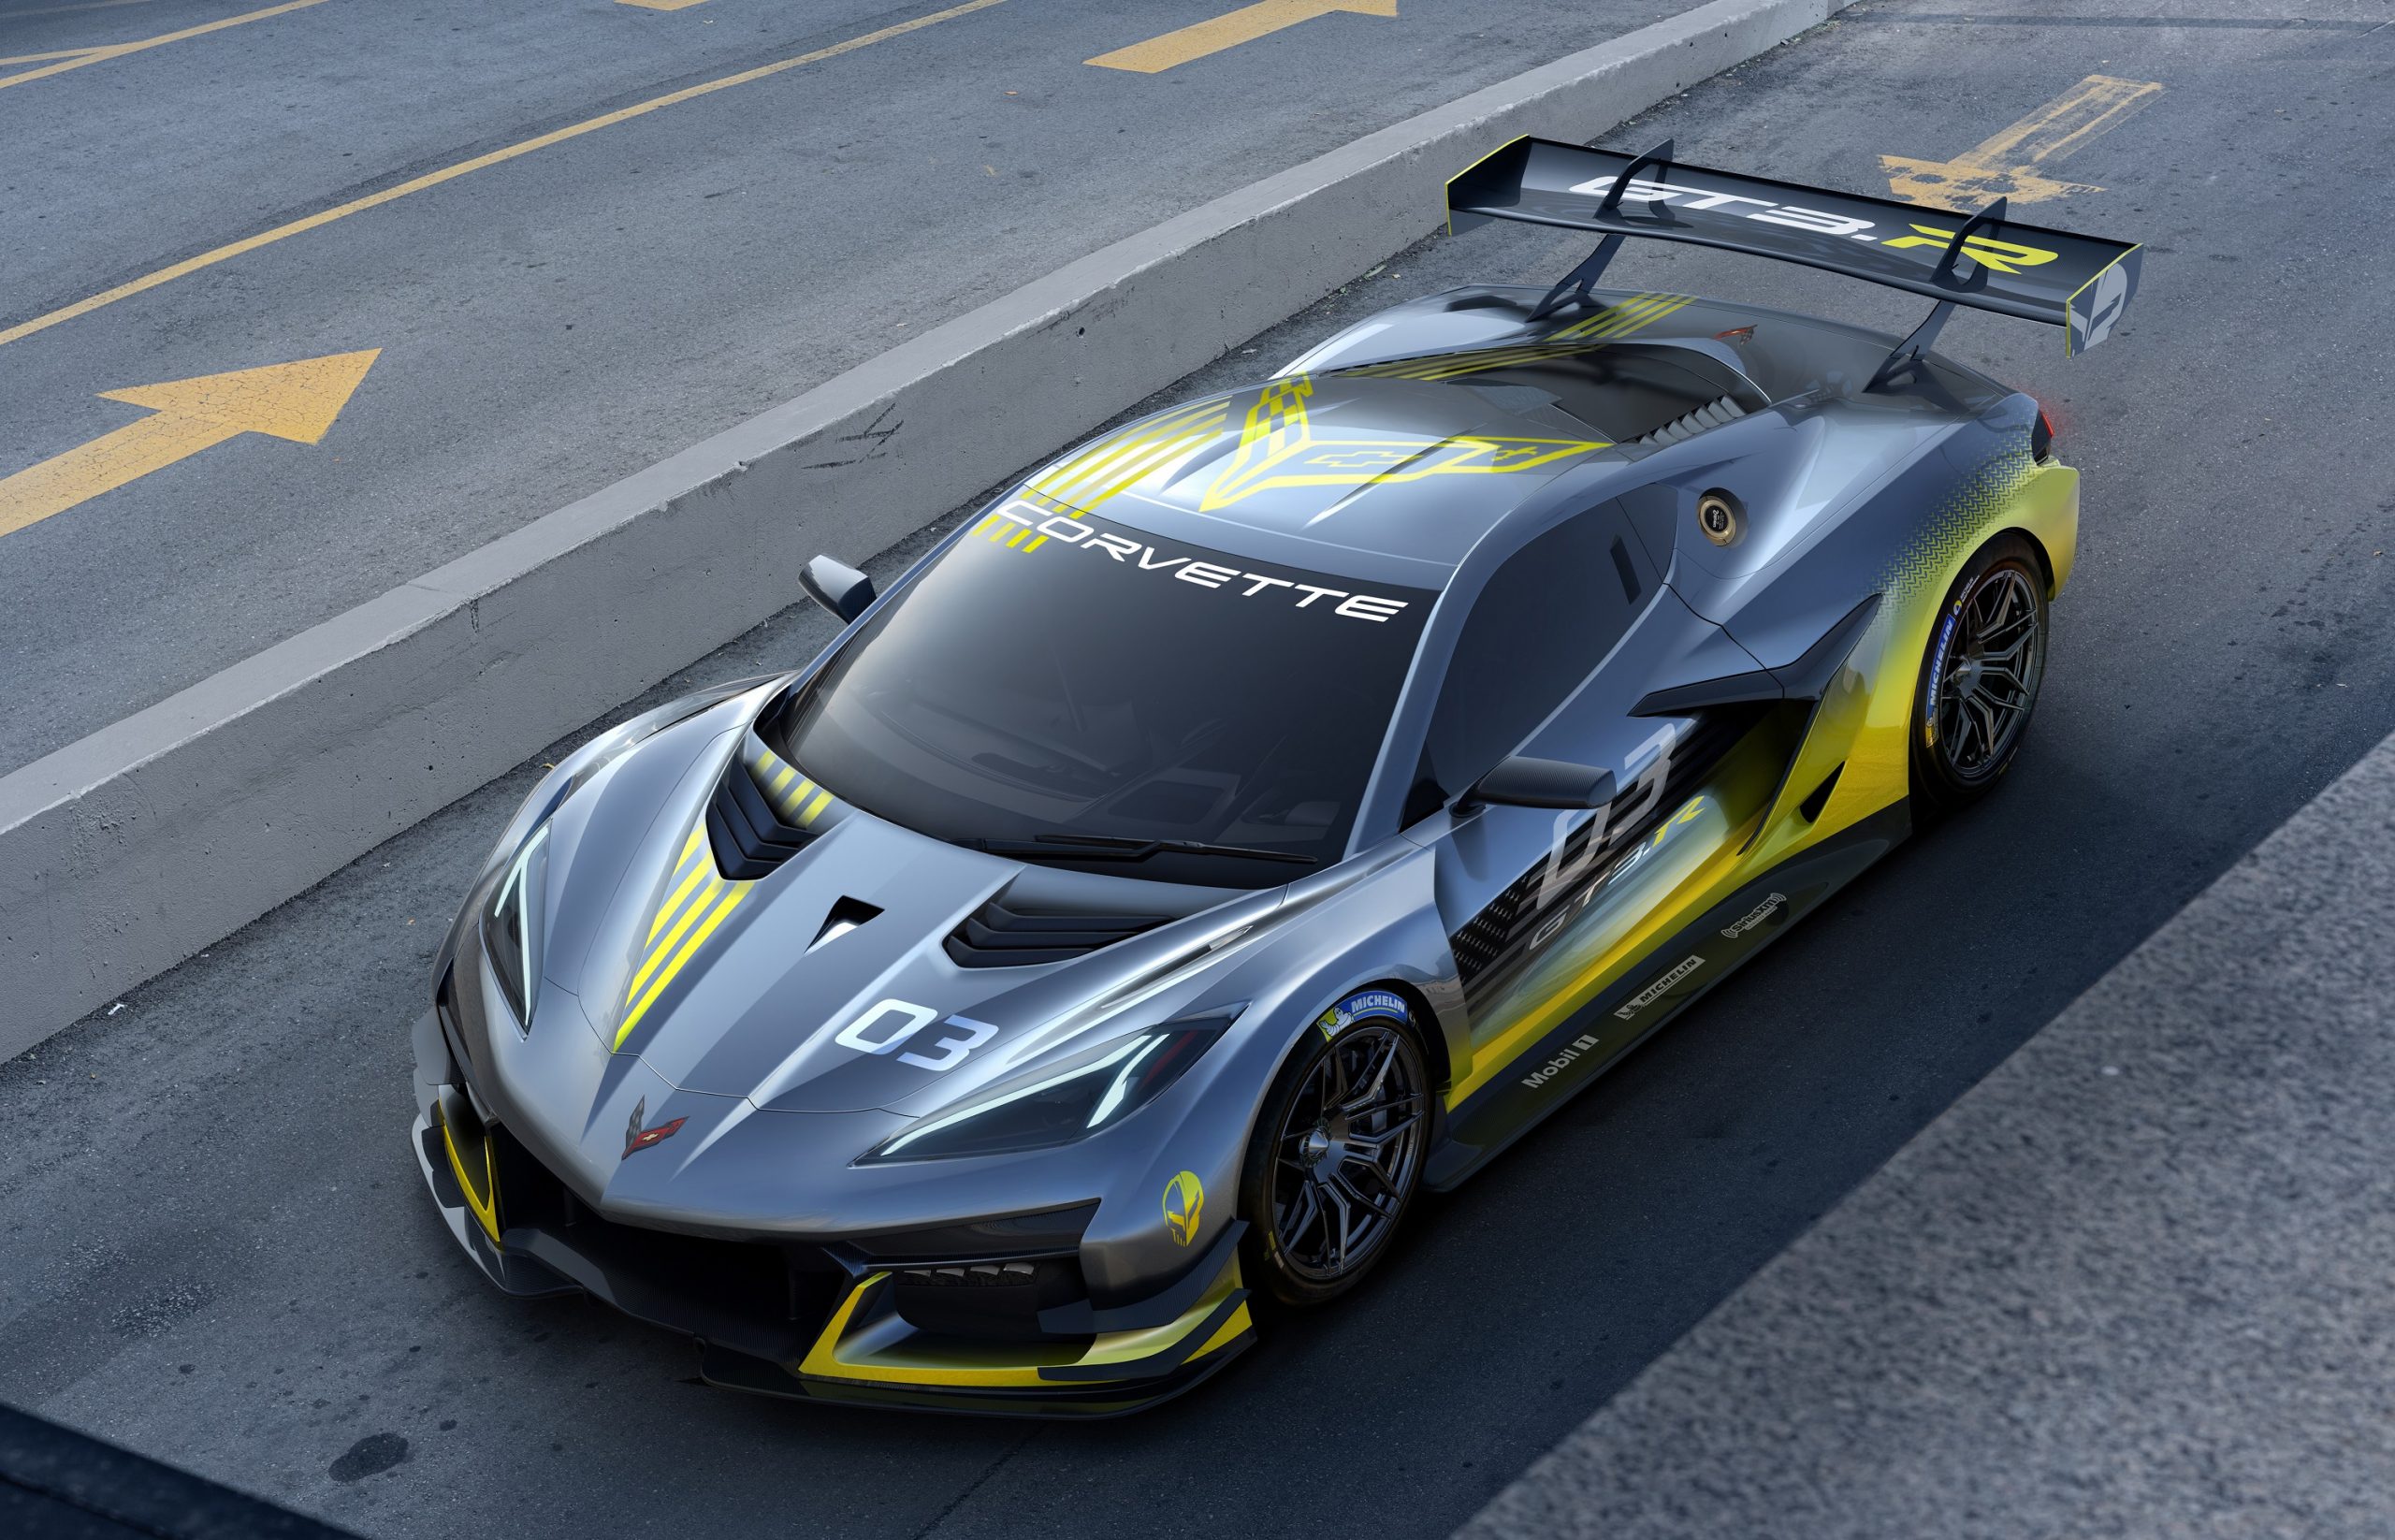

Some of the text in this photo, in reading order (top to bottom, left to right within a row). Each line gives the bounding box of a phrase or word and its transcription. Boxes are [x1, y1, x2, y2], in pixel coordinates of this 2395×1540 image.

[997, 500, 1409, 623] CORVETTE
[1929, 618, 1954, 707] MICHELIN
[1536, 722, 1676, 910] 03
[1350, 995, 1406, 1013] MICHELIN
[1640, 958, 1698, 1003] MICHELIN
[835, 998, 999, 1071] 03
[1521, 1048, 1580, 1089] Mobil
